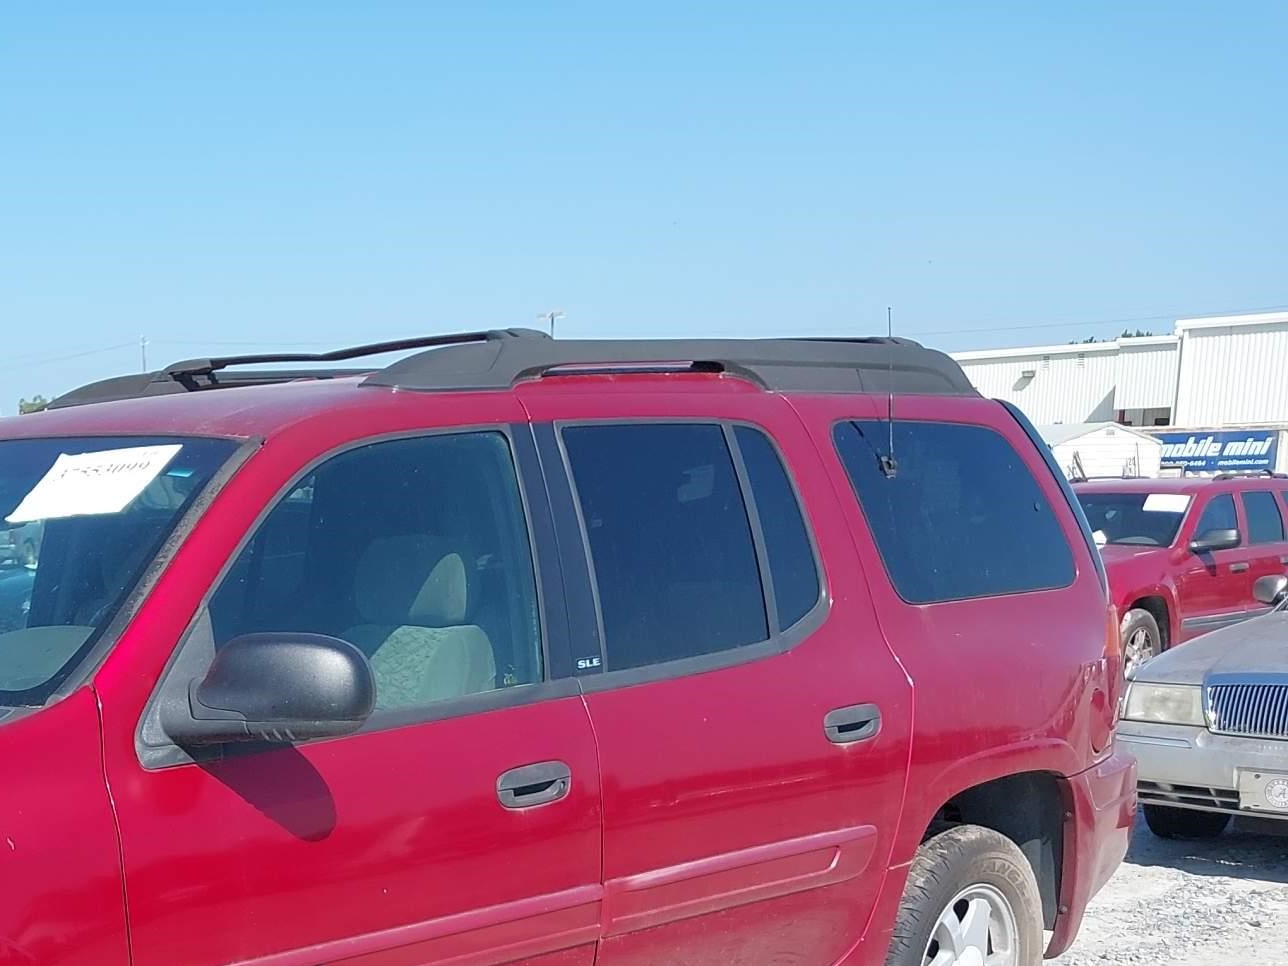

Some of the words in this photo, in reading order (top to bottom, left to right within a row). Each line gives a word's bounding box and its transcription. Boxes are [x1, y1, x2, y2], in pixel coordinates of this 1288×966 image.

[1160, 436, 1223, 457] mobile
[1222, 436, 1273, 456] mini
[577, 657, 601, 669] SLE
